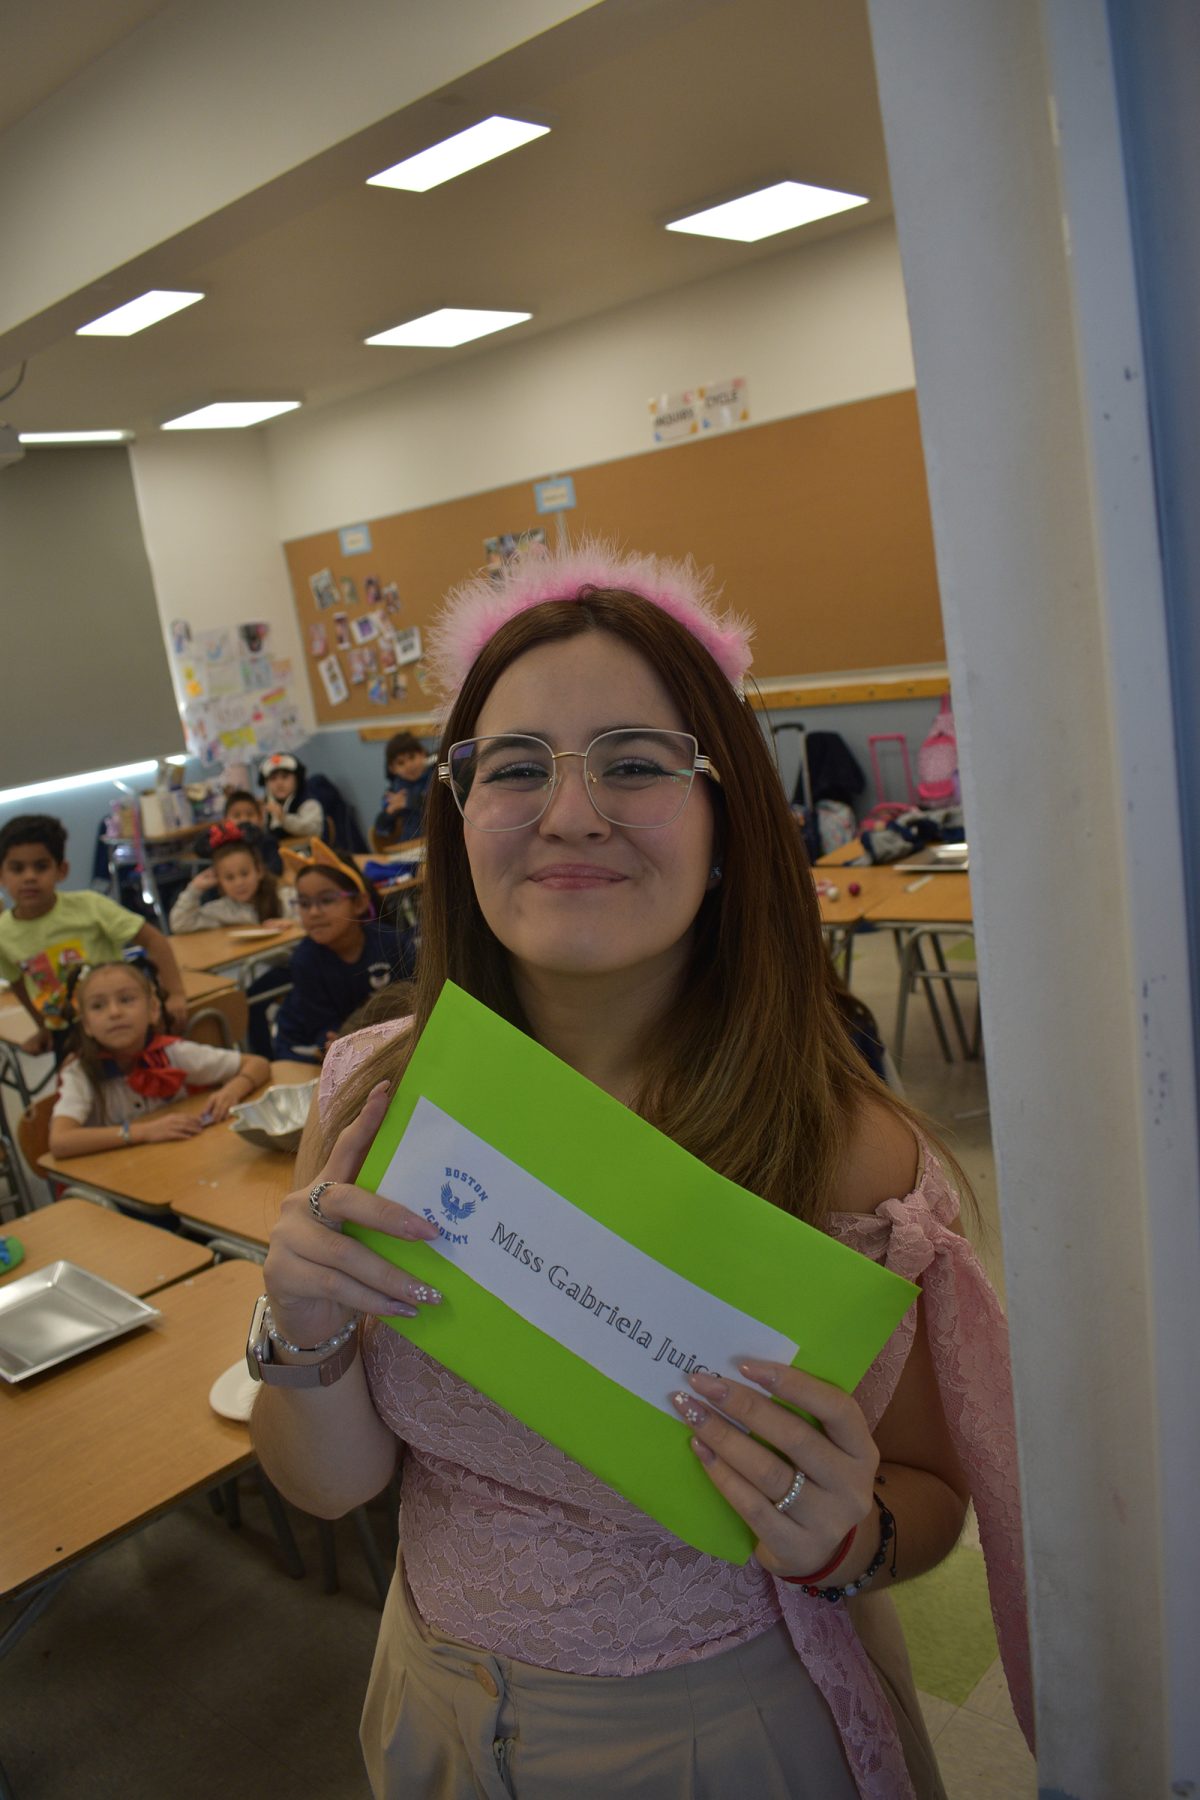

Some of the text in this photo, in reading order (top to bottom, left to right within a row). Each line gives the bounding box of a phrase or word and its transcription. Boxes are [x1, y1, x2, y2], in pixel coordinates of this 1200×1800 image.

[445, 1167, 488, 1202] BOSTON
[490, 1221, 722, 1379] Miss Gabriela Juic
